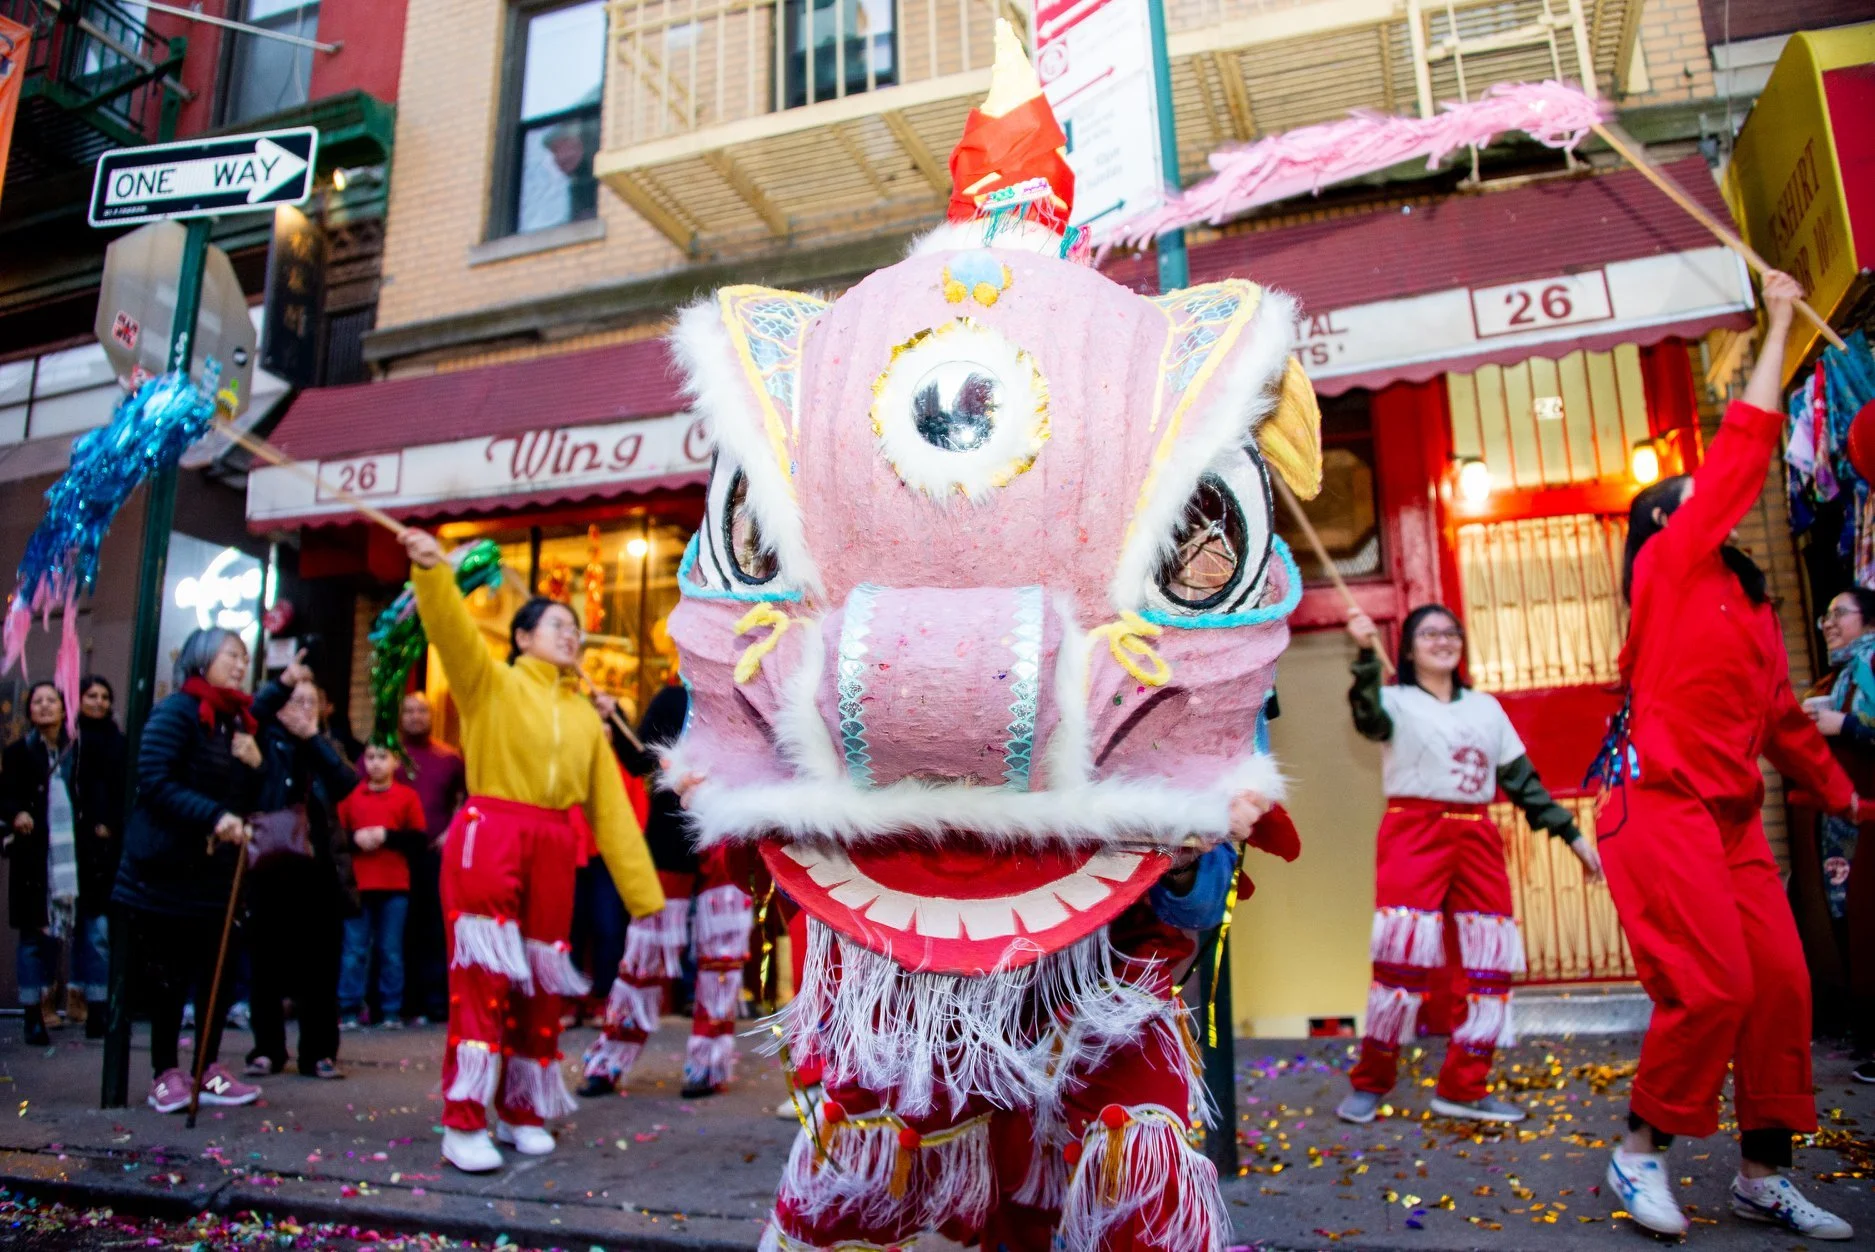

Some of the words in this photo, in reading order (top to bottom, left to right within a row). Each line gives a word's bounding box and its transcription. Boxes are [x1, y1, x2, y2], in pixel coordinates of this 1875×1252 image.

[115, 168, 176, 198] ONE
[214, 153, 281, 187] WAY
[1768, 137, 1820, 263] T-SHIRT
[1504, 285, 1572, 326] 26
[485, 429, 644, 479] Wing
[340, 461, 377, 493] 26
[155, 1083, 169, 1098] N
[205, 1075, 232, 1095] N
